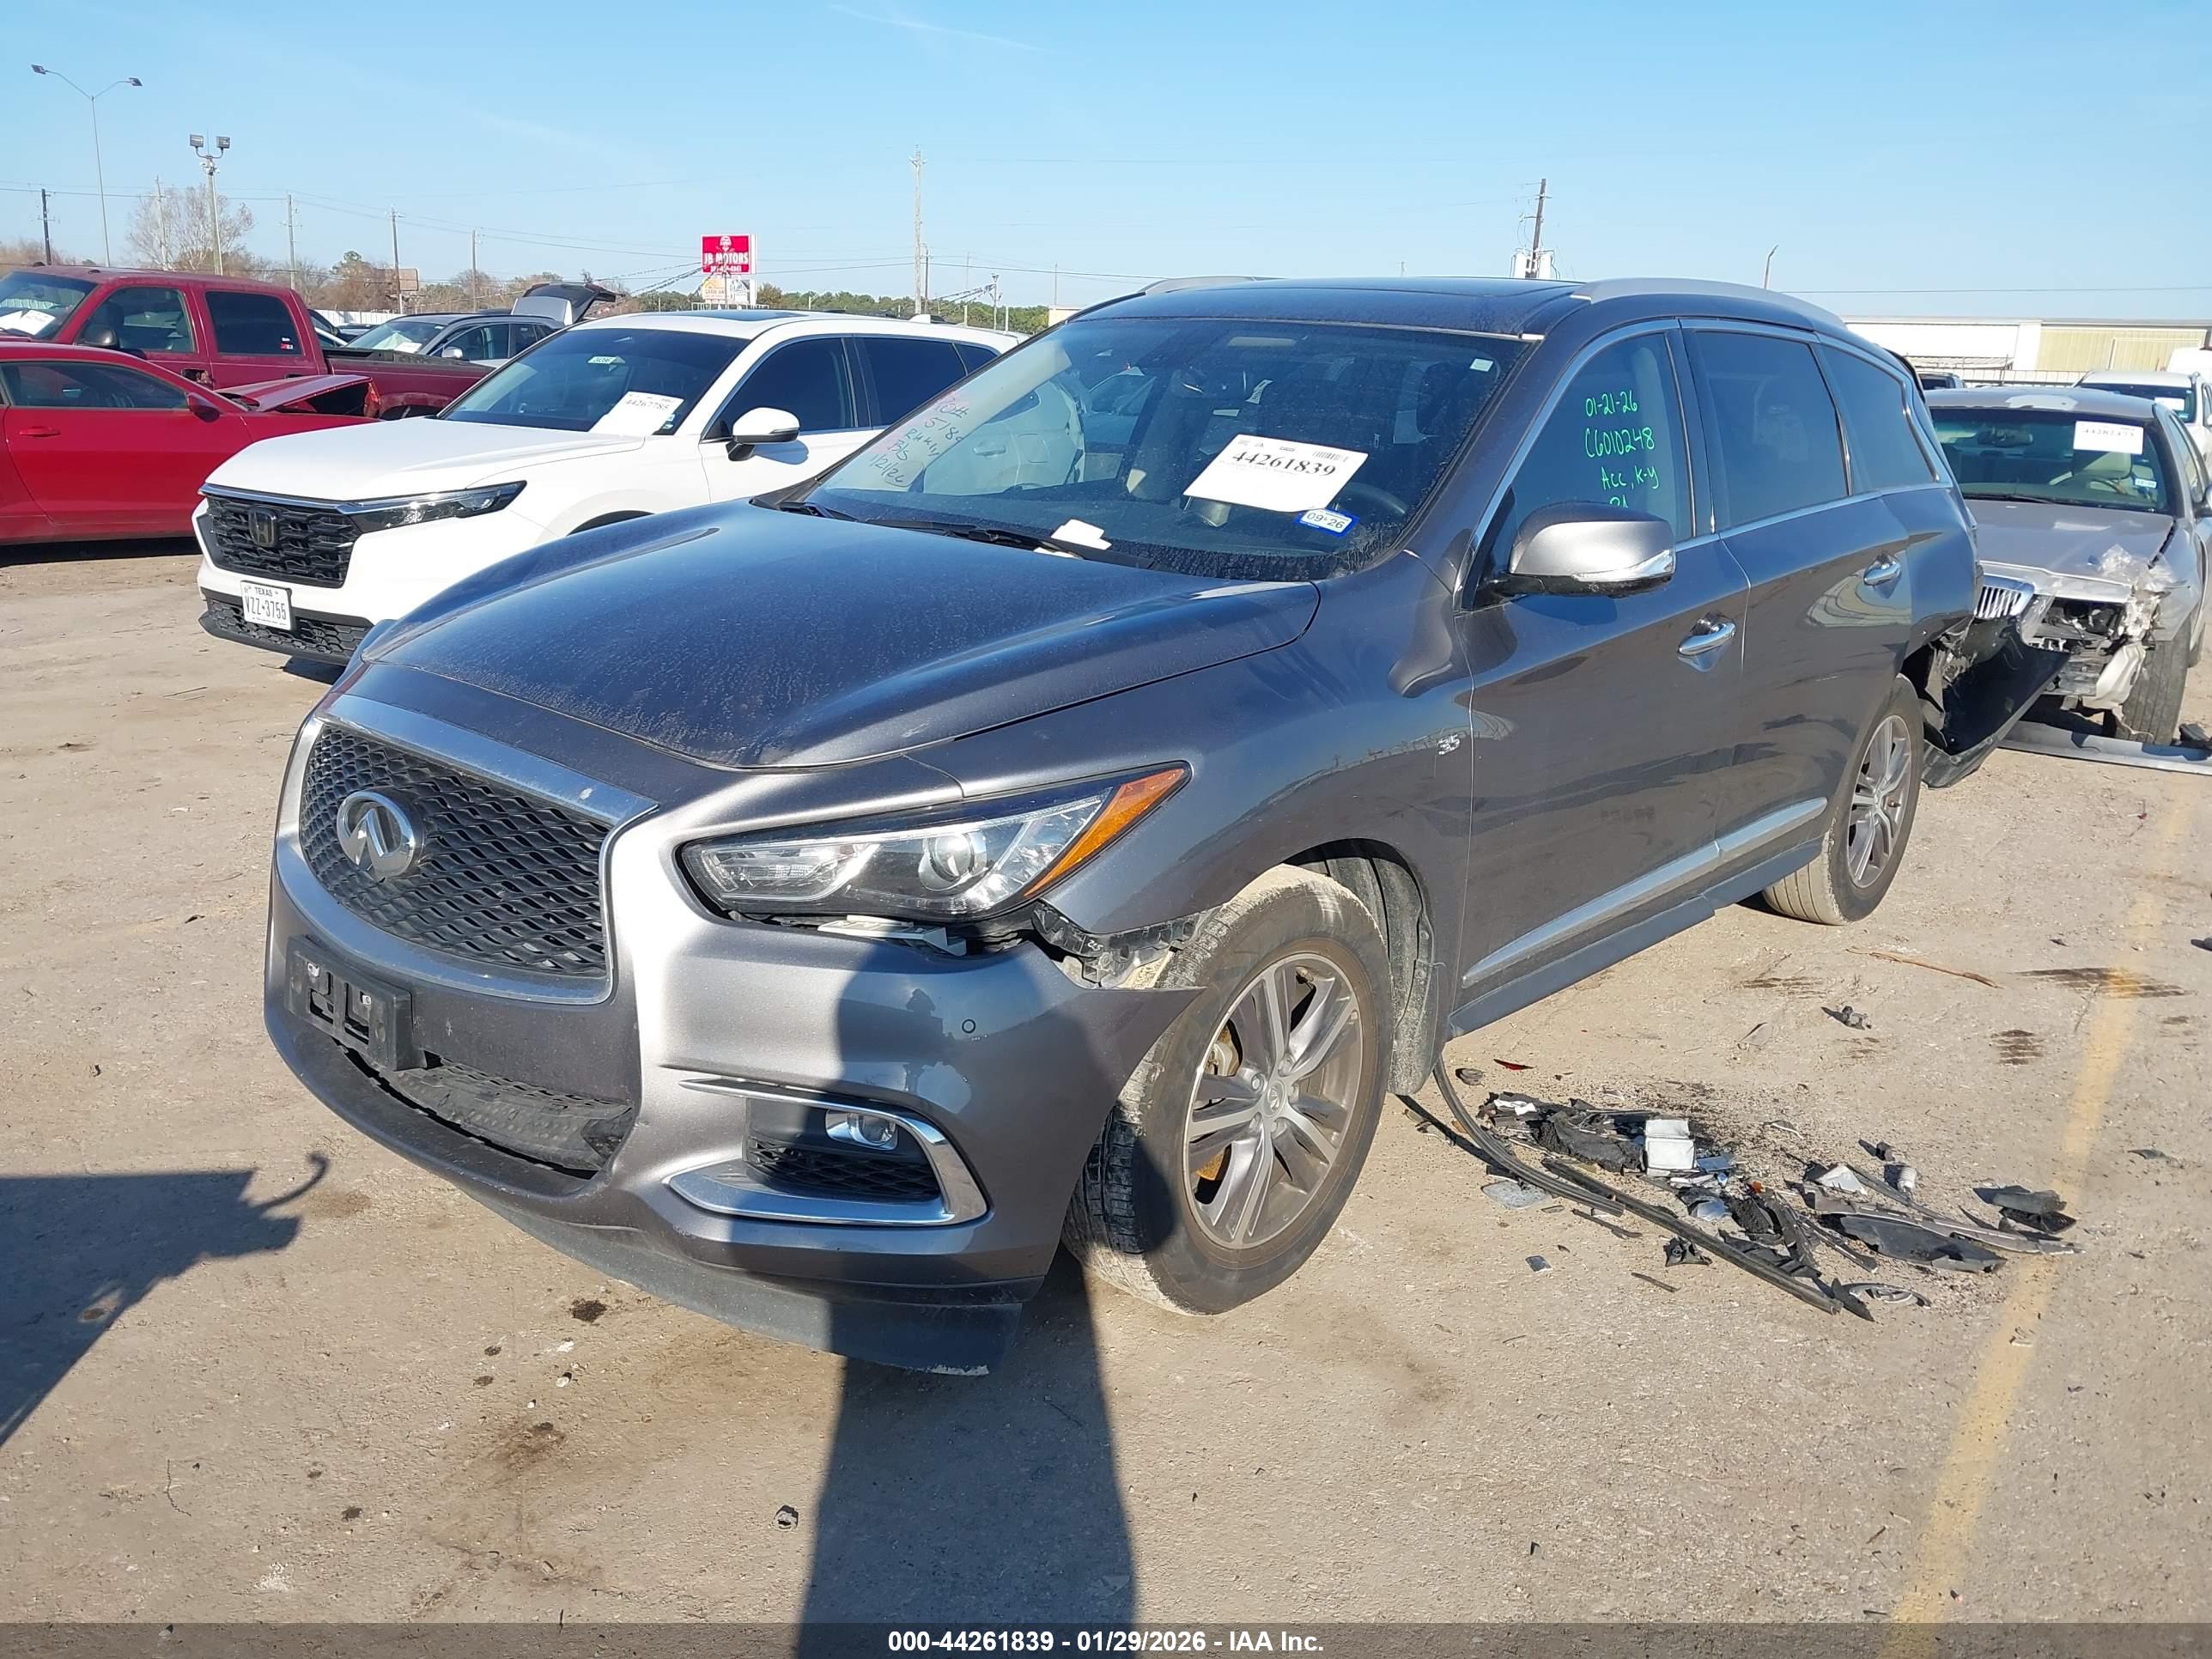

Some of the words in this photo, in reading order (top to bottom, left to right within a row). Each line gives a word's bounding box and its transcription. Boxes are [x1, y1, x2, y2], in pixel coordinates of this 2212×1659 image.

[704, 252, 714, 264] JB
[715, 252, 749, 264] MOTORS
[1585, 390, 1638, 417] 01-21-26
[1584, 426, 1656, 458] C6010248
[1232, 451, 1336, 477] 44261839
[254, 586, 273, 597] TEXAS
